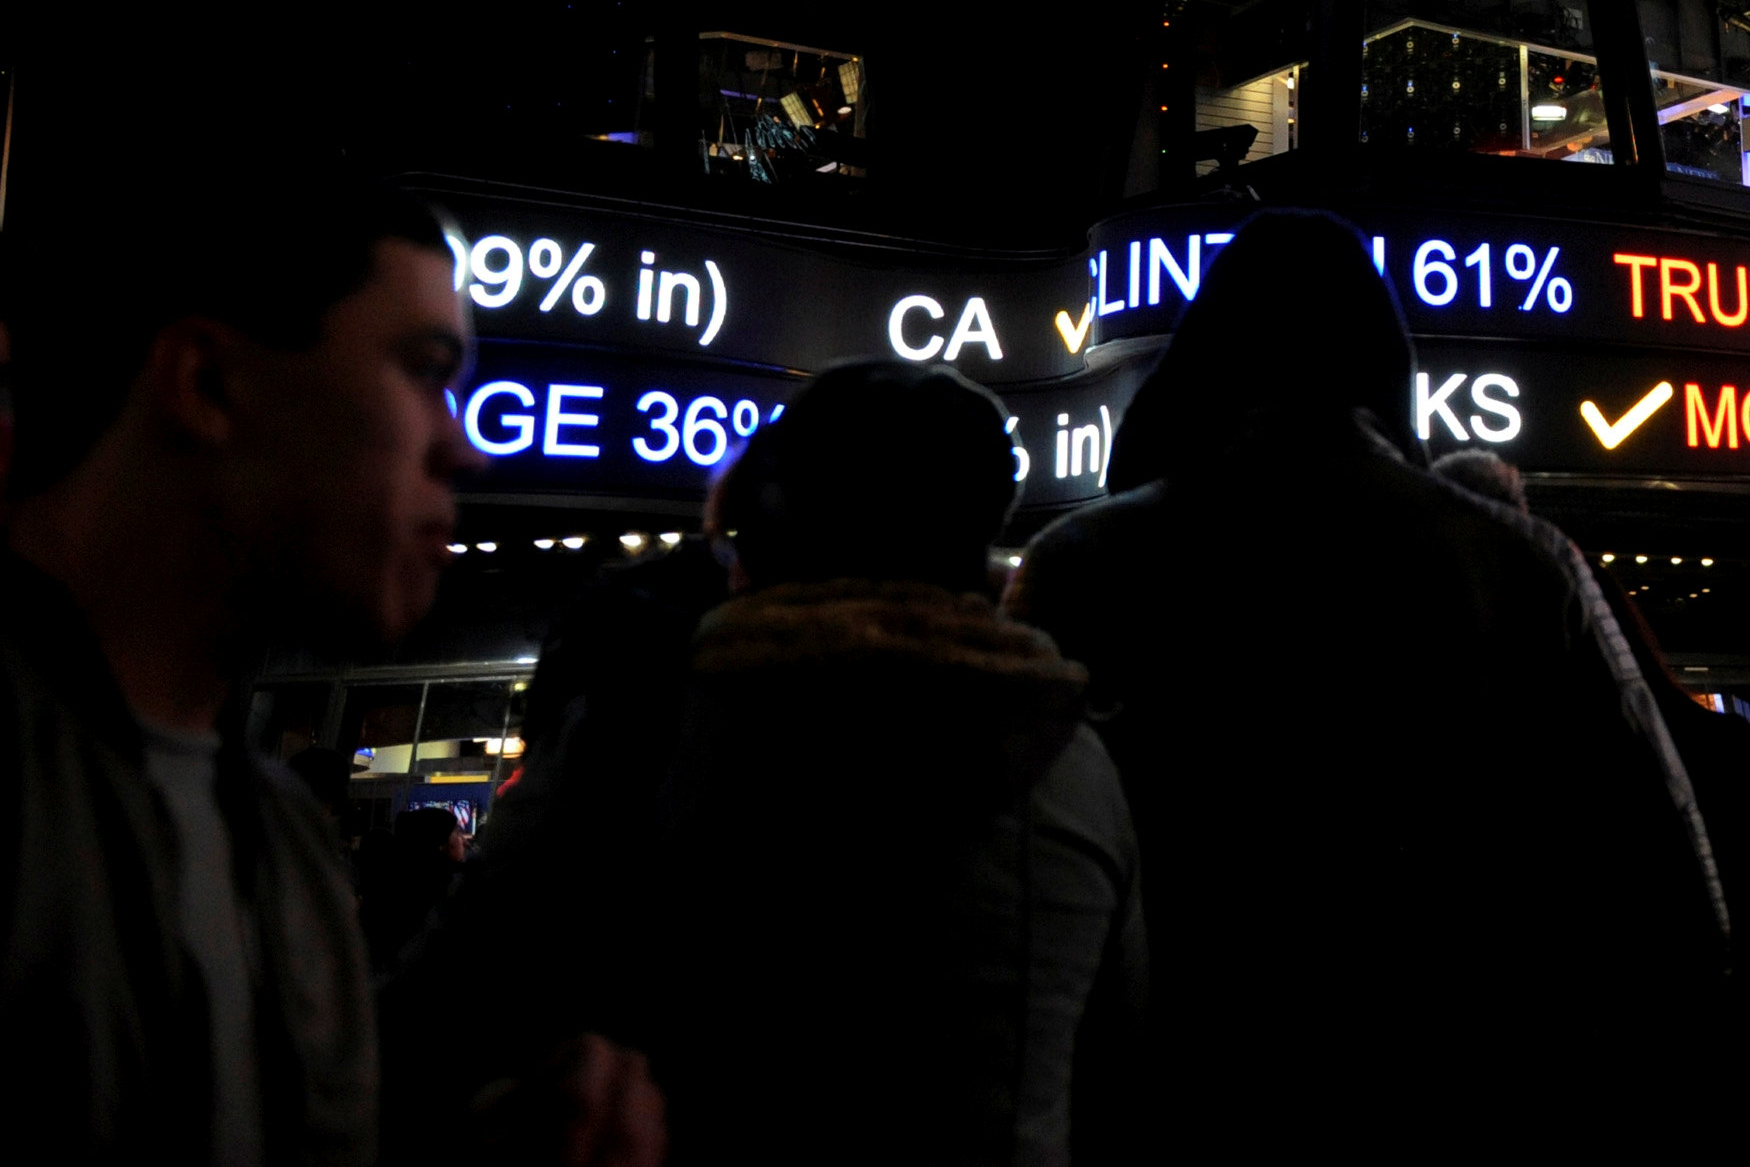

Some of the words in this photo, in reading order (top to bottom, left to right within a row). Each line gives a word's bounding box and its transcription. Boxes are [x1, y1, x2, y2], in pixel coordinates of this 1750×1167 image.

[636, 251, 727, 346] in)
[888, 294, 1003, 361] CA
[1413, 238, 1573, 314] 61%
[445, 380, 604, 458] GE
[1415, 372, 1521, 444] KS
